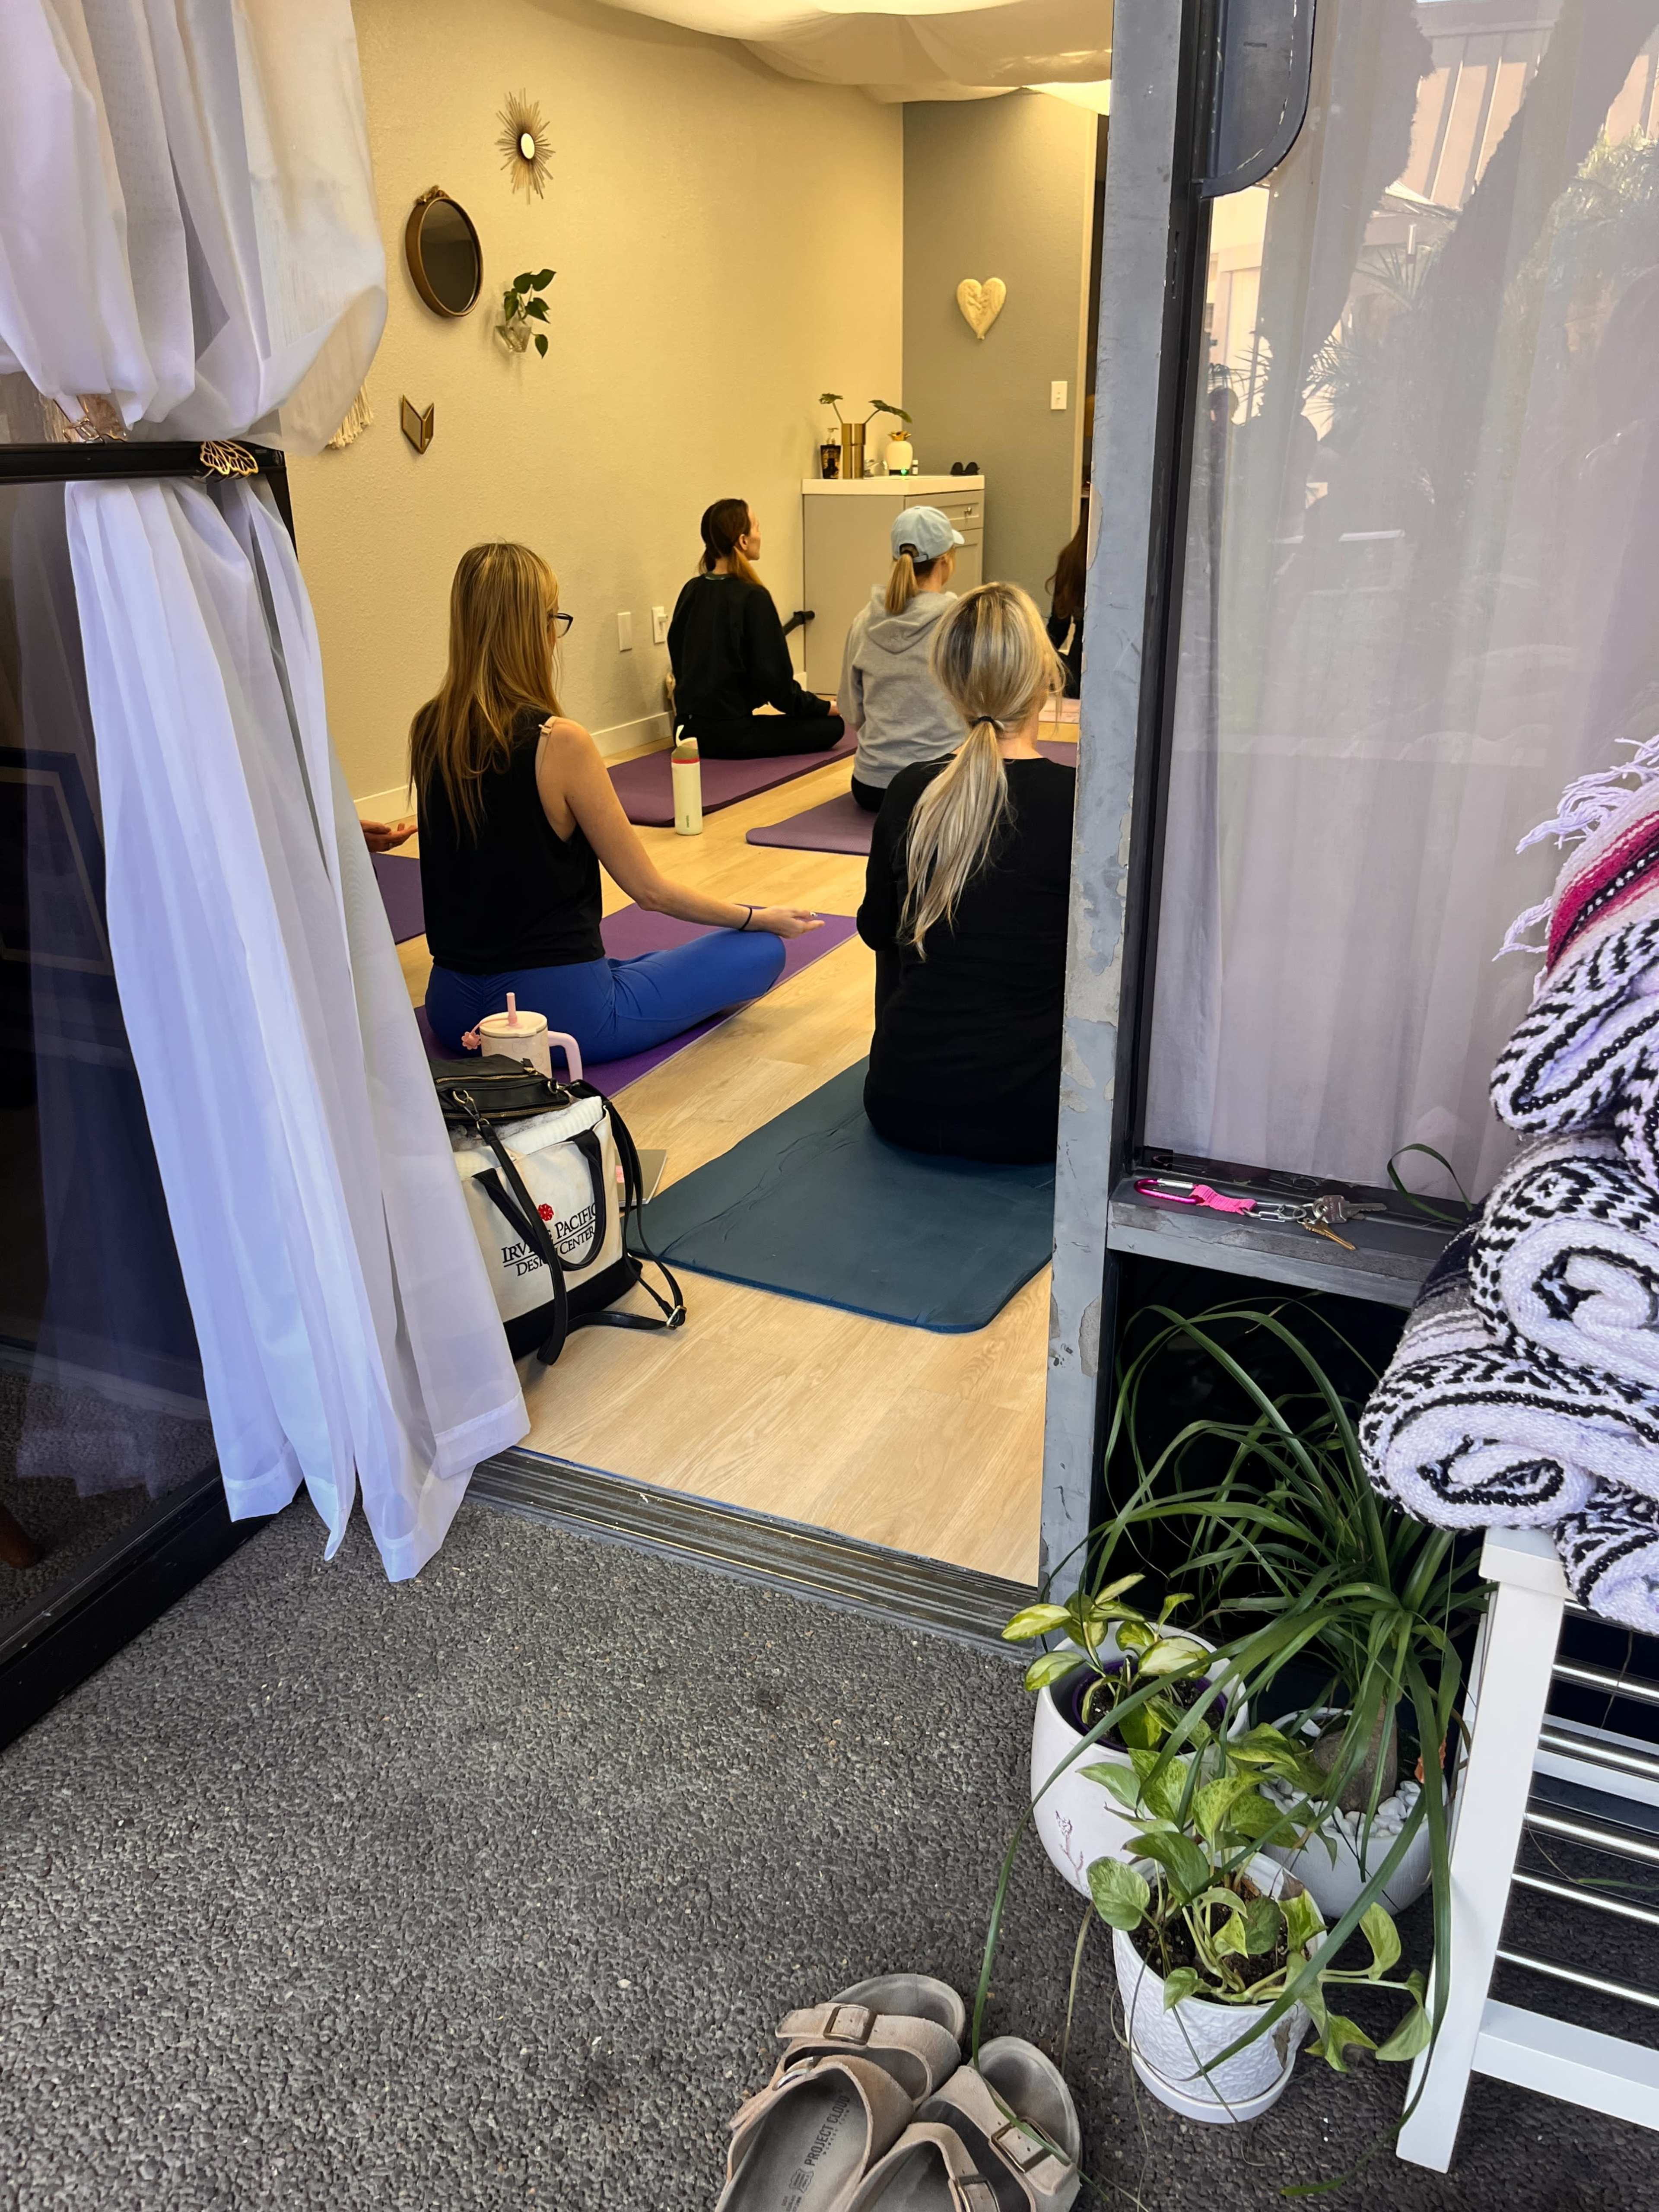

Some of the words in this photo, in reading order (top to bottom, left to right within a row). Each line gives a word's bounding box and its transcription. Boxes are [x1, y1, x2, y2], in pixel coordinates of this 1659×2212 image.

[501, 1230, 552, 1263] IRV
[560, 1226, 595, 1254] CENTER
[804, 2123, 833, 2166] PROJECT
[826, 2095, 850, 2123] CLOUD
